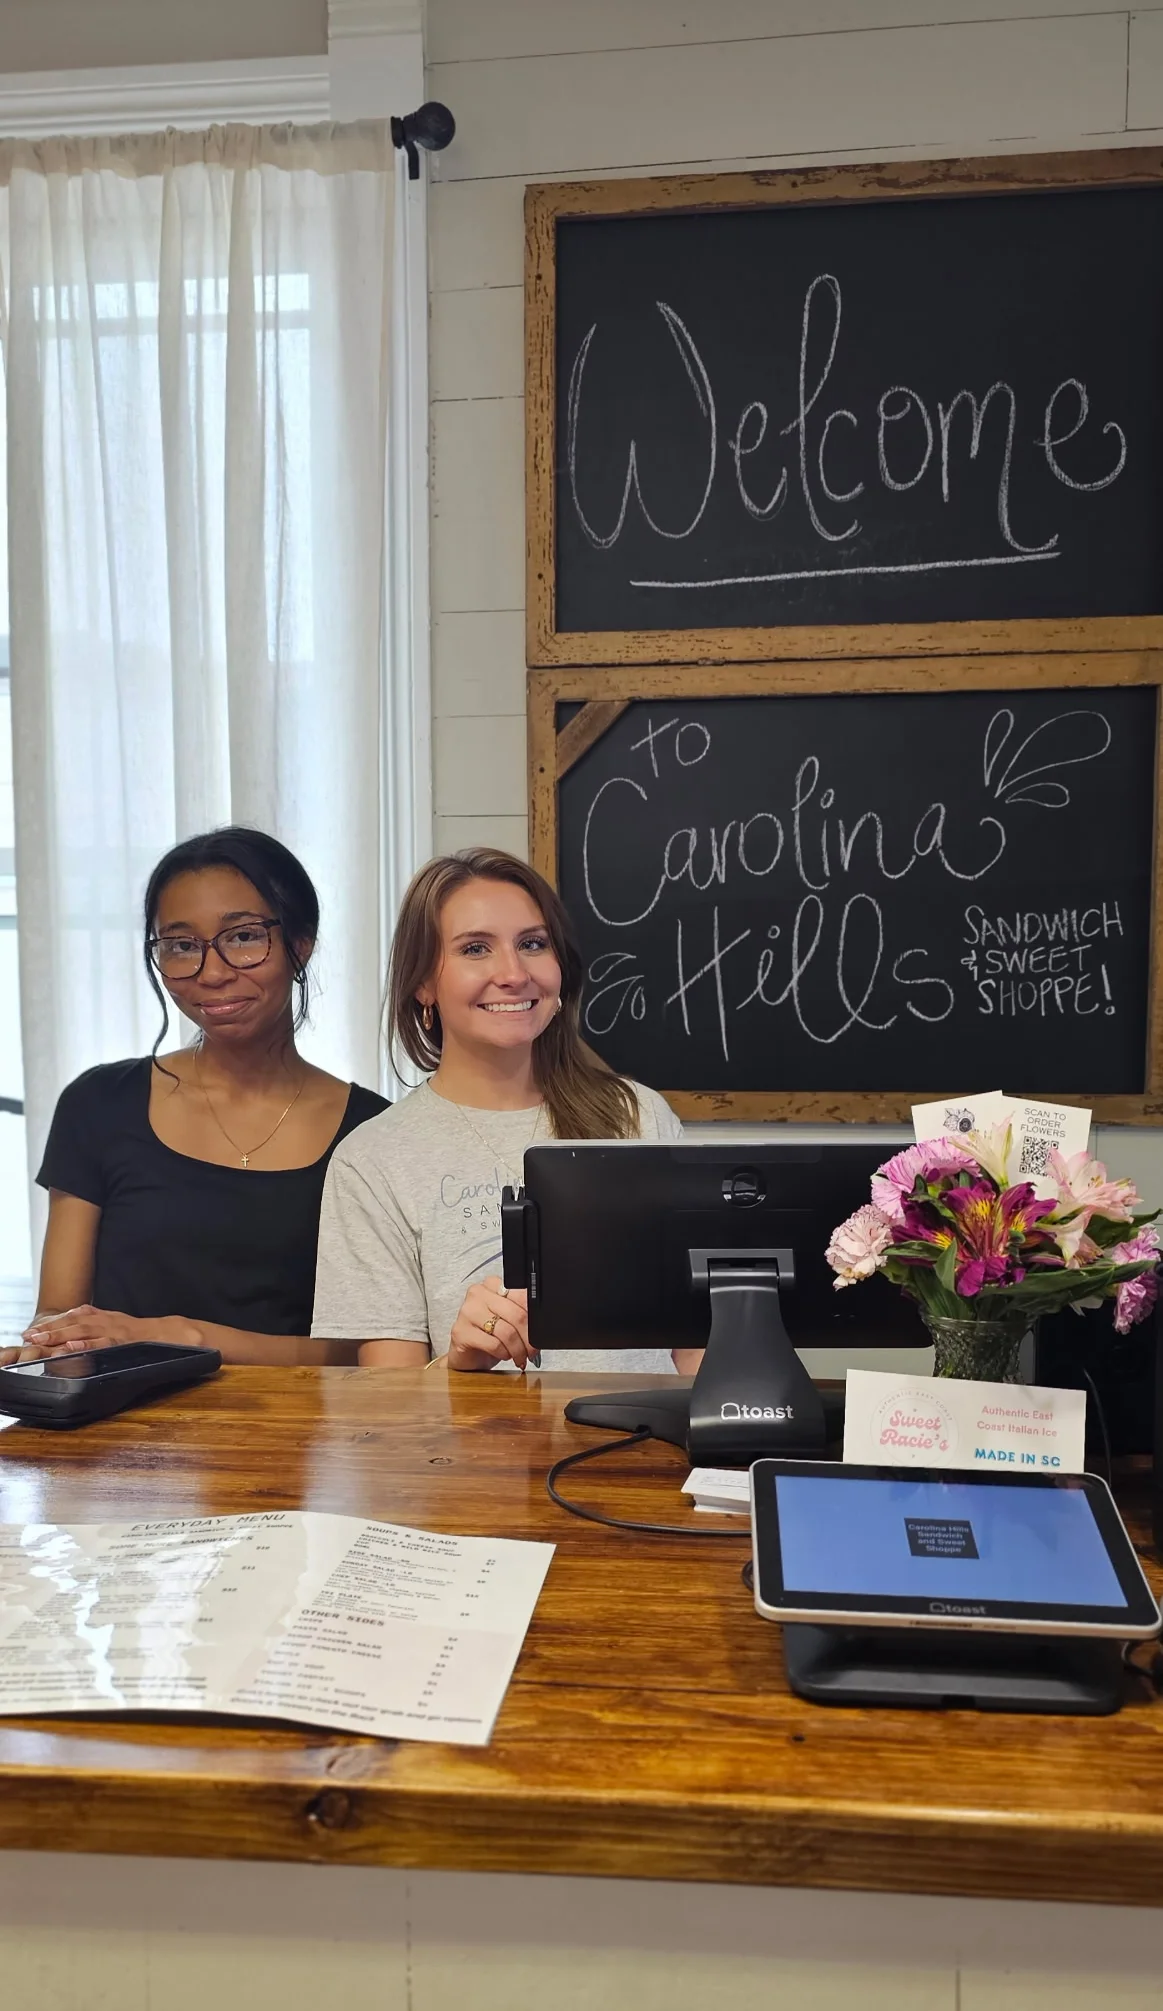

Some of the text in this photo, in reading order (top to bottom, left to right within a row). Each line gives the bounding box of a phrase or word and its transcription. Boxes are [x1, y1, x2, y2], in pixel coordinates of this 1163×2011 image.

[568, 273, 1127, 553] Welcome
[584, 756, 1006, 925] Carolina
[963, 902, 1123, 946] SANDWICH
[986, 944, 1092, 975] SWEET
[665, 893, 954, 1061] Hills
[979, 964, 1116, 1016] SHOPPE!
[1024, 1107, 1067, 1121] SCAN TO
[1027, 1116, 1061, 1128] ORDER
[1020, 1124, 1066, 1138] FLOWERS
[741, 1405, 794, 1419] toast
[890, 1410, 941, 1431] Sweet
[981, 1405, 1053, 1422] Authentic East
[977, 1421, 1058, 1438] Coast Italian Ice
[880, 1428, 949, 1451] Racie's
[974, 1448, 1061, 1467] MADE IN SC
[131, 1518, 228, 1531] EVERYDAY
[236, 1514, 285, 1524] MENU
[908, 1524, 969, 1533] Carolina Hills
[418, 1535, 458, 1546] SALADS
[918, 1531, 963, 1539] Sandwich
[918, 1537, 966, 1546] and Sweet
[926, 1545, 962, 1553] Shoppe
[945, 1602, 986, 1615] toast
[301, 1608, 340, 1619] OTHER
[346, 1615, 385, 1627] SIDES
